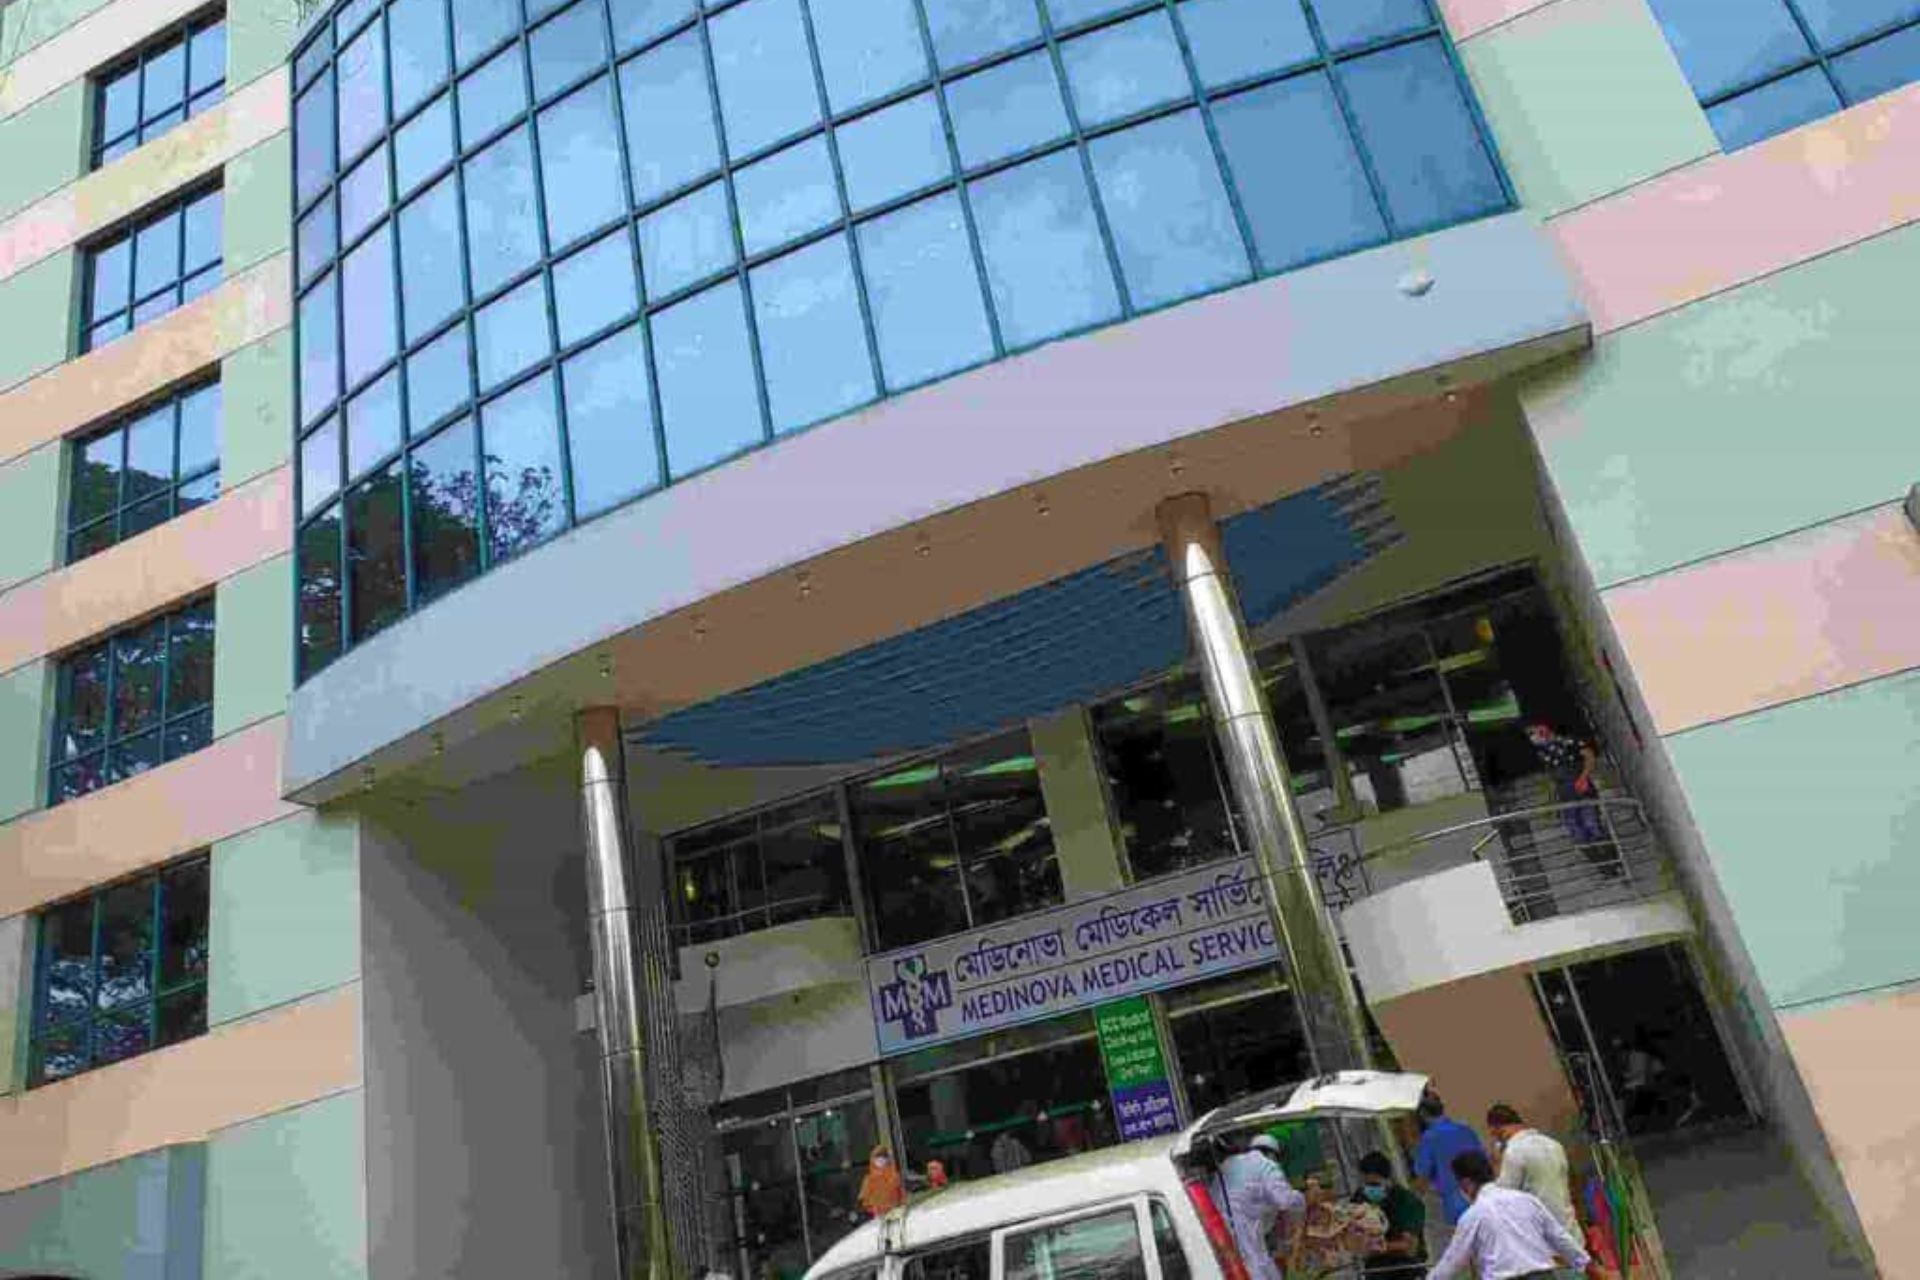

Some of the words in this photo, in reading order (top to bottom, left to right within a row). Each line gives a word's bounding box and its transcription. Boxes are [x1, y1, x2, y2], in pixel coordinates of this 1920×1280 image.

[955, 928, 1066, 982] মেডিনোভা
[1076, 906, 1182, 950] মেডিকেল
[962, 973, 1077, 1024] MEDINOVA
[1082, 945, 1185, 993] MEDICAL
[1189, 921, 1274, 965] SERVIC
